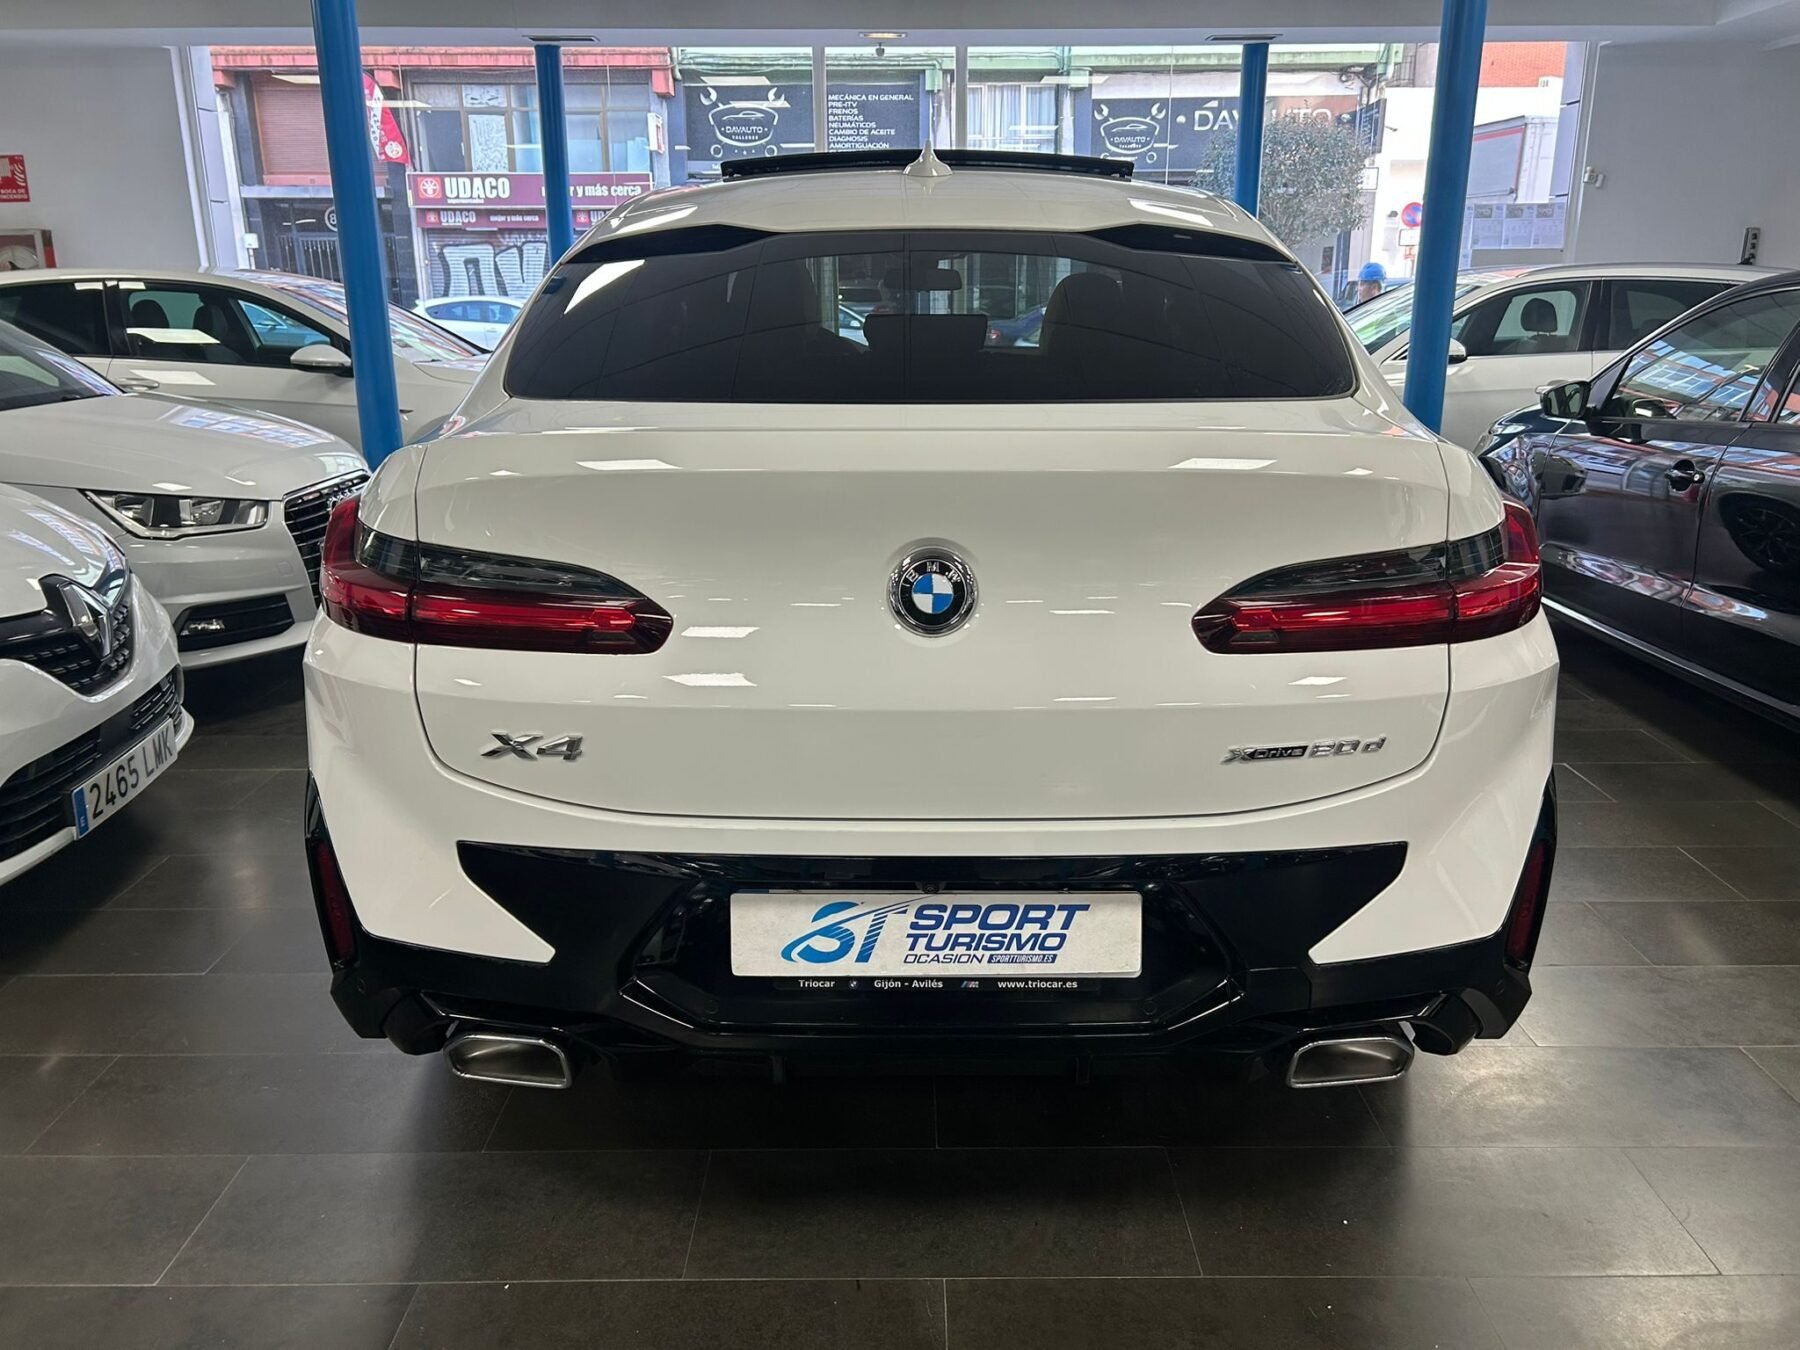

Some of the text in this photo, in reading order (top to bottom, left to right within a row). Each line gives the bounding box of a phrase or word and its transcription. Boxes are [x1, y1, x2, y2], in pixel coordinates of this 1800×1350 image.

[444, 177, 510, 199] UDACO
[585, 183, 608, 196] más
[611, 186, 641, 196] cerca
[330, 214, 337, 224] 8
[440, 211, 476, 223] UDACO
[481, 733, 583, 761] X4
[89, 726, 172, 819] 2465 LMK
[909, 904, 1091, 931] SPORT
[906, 933, 1067, 952] TURISMO
[904, 953, 1055, 964] OCASION SPORTTURISMO.ES
[798, 979, 835, 988] Triocar
[874, 979, 901, 990] Gijón
[911, 979, 944, 988] Avilés
[998, 980, 1078, 988] www.triocar.es
